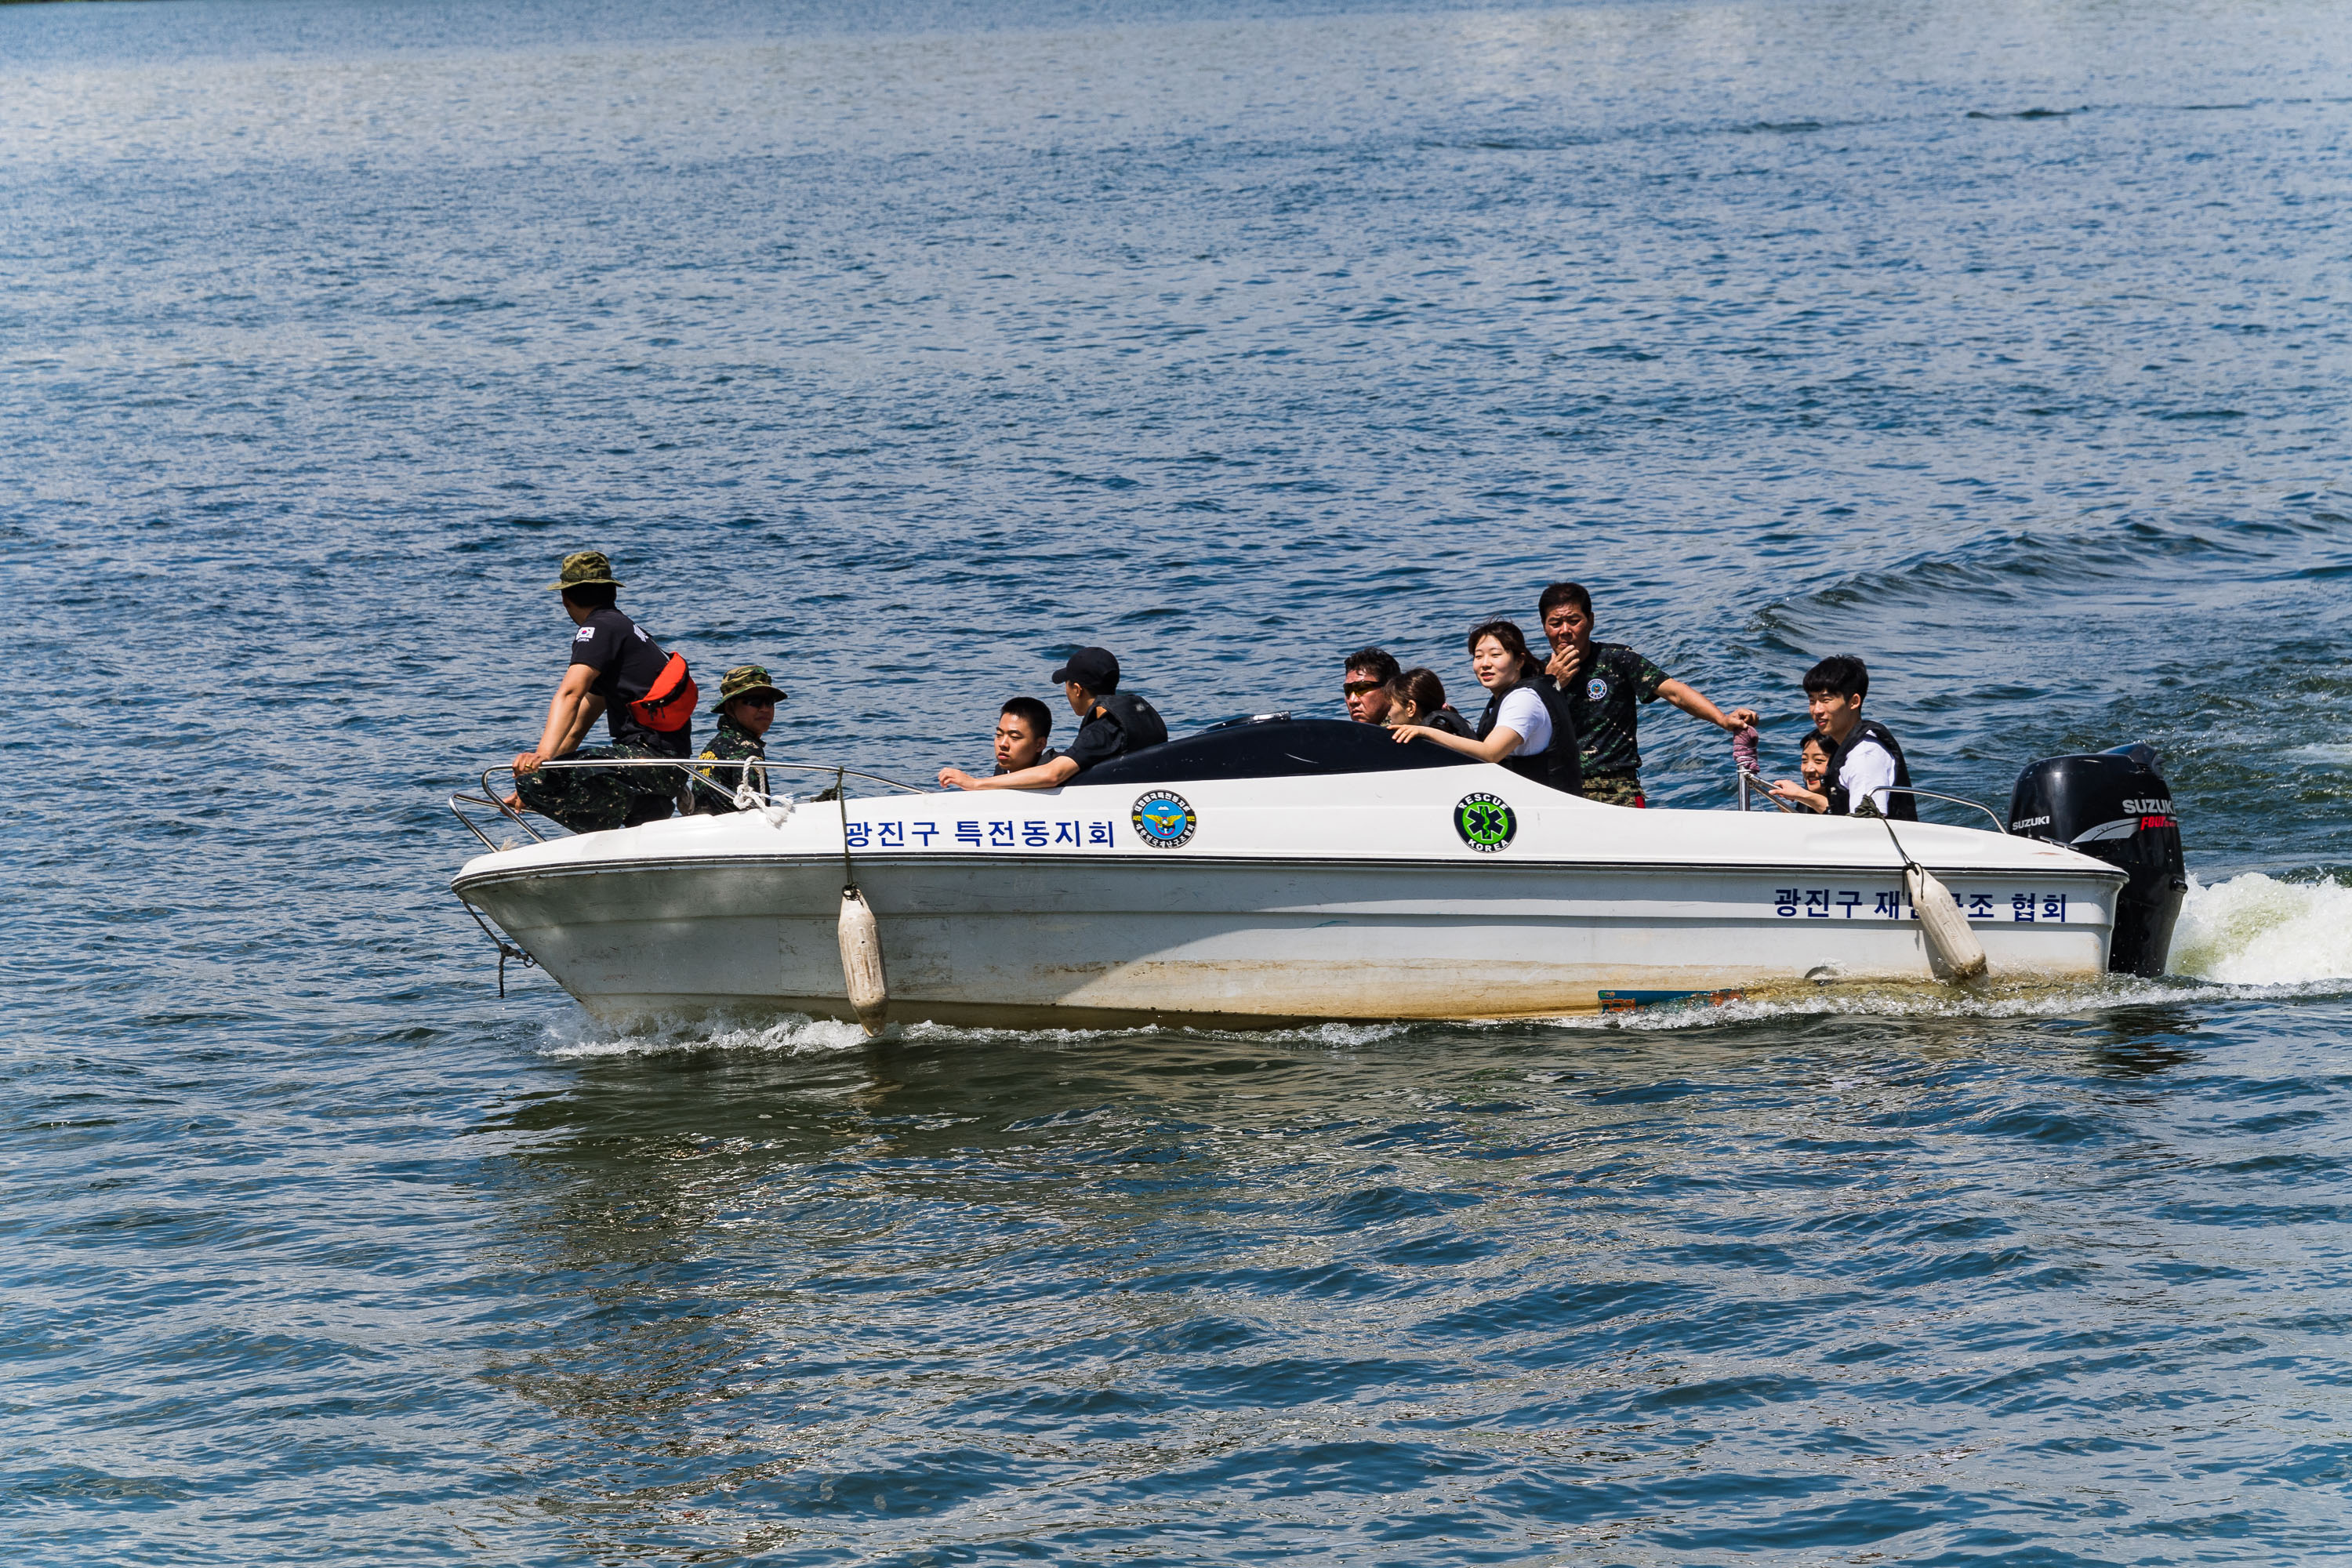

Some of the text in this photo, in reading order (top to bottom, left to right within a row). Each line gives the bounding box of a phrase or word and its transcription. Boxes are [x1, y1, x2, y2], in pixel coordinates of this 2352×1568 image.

[1457, 793, 1508, 811] RESCUE
[2012, 815, 2050, 831] SUZUKI
[846, 820, 1114, 848] 광진구 특전동지회
[1468, 838, 1509, 852] KOREA
[1774, 887, 2067, 923] 광진구 재조 협회
